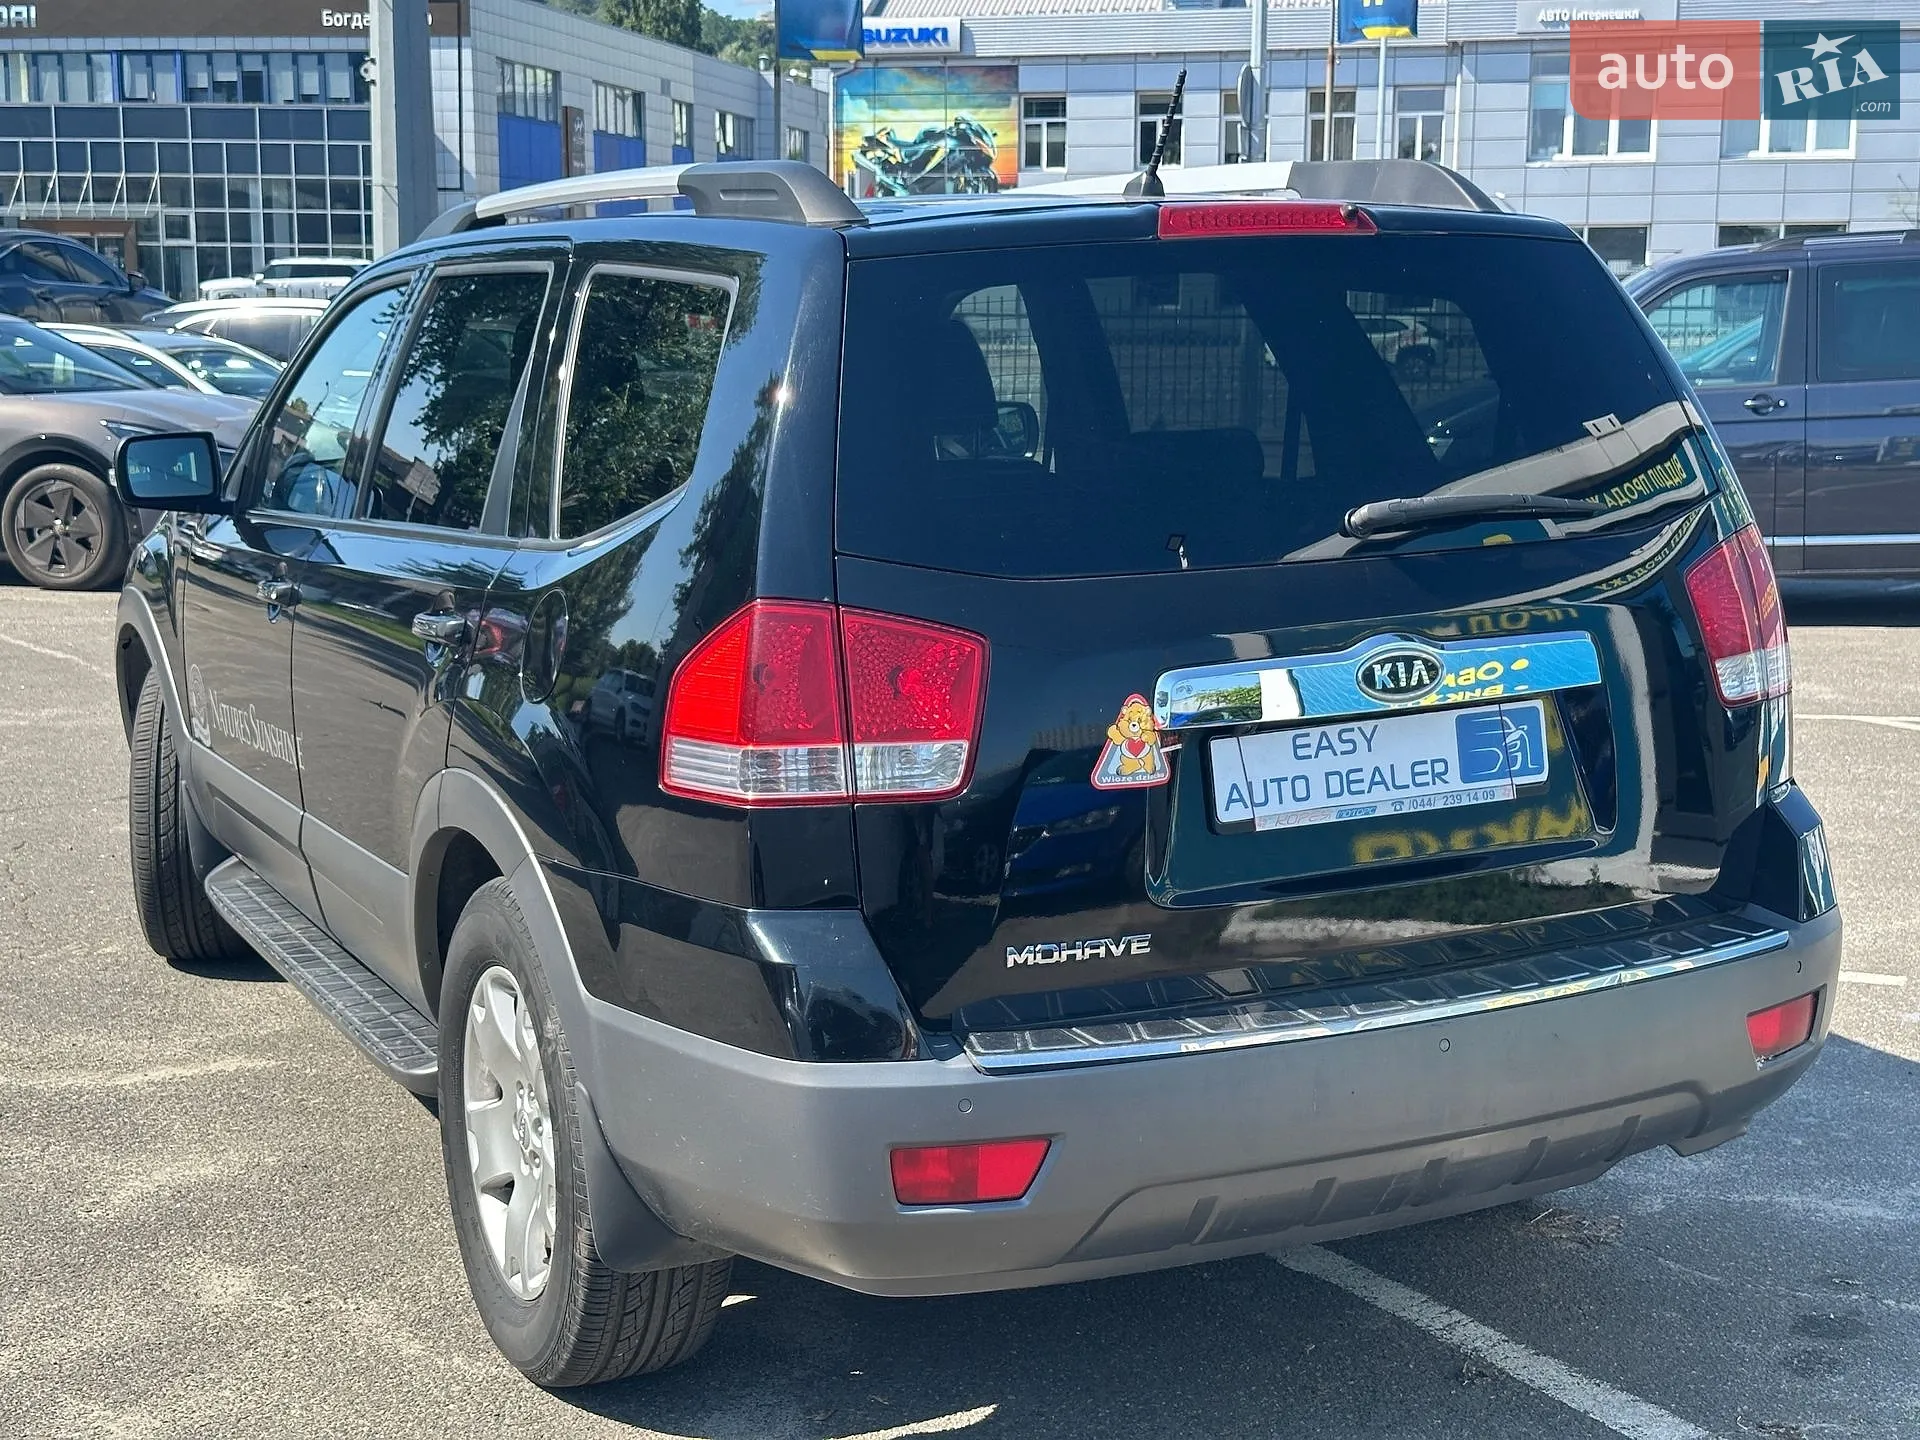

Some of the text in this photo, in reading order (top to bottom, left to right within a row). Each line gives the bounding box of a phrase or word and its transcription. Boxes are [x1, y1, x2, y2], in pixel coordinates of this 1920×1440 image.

[321, 8, 370, 30] Богда
[1538, 8, 1570, 22] АВТО
[1372, 659, 1431, 690] KIA
[1292, 724, 1379, 760] EASY
[1224, 757, 1450, 811] AUTO DEALER
[1442, 793, 1463, 807] 239
[1466, 792, 1479, 803] 14
[1482, 789, 1496, 801] 09
[1006, 933, 1152, 969] MOHAVE
